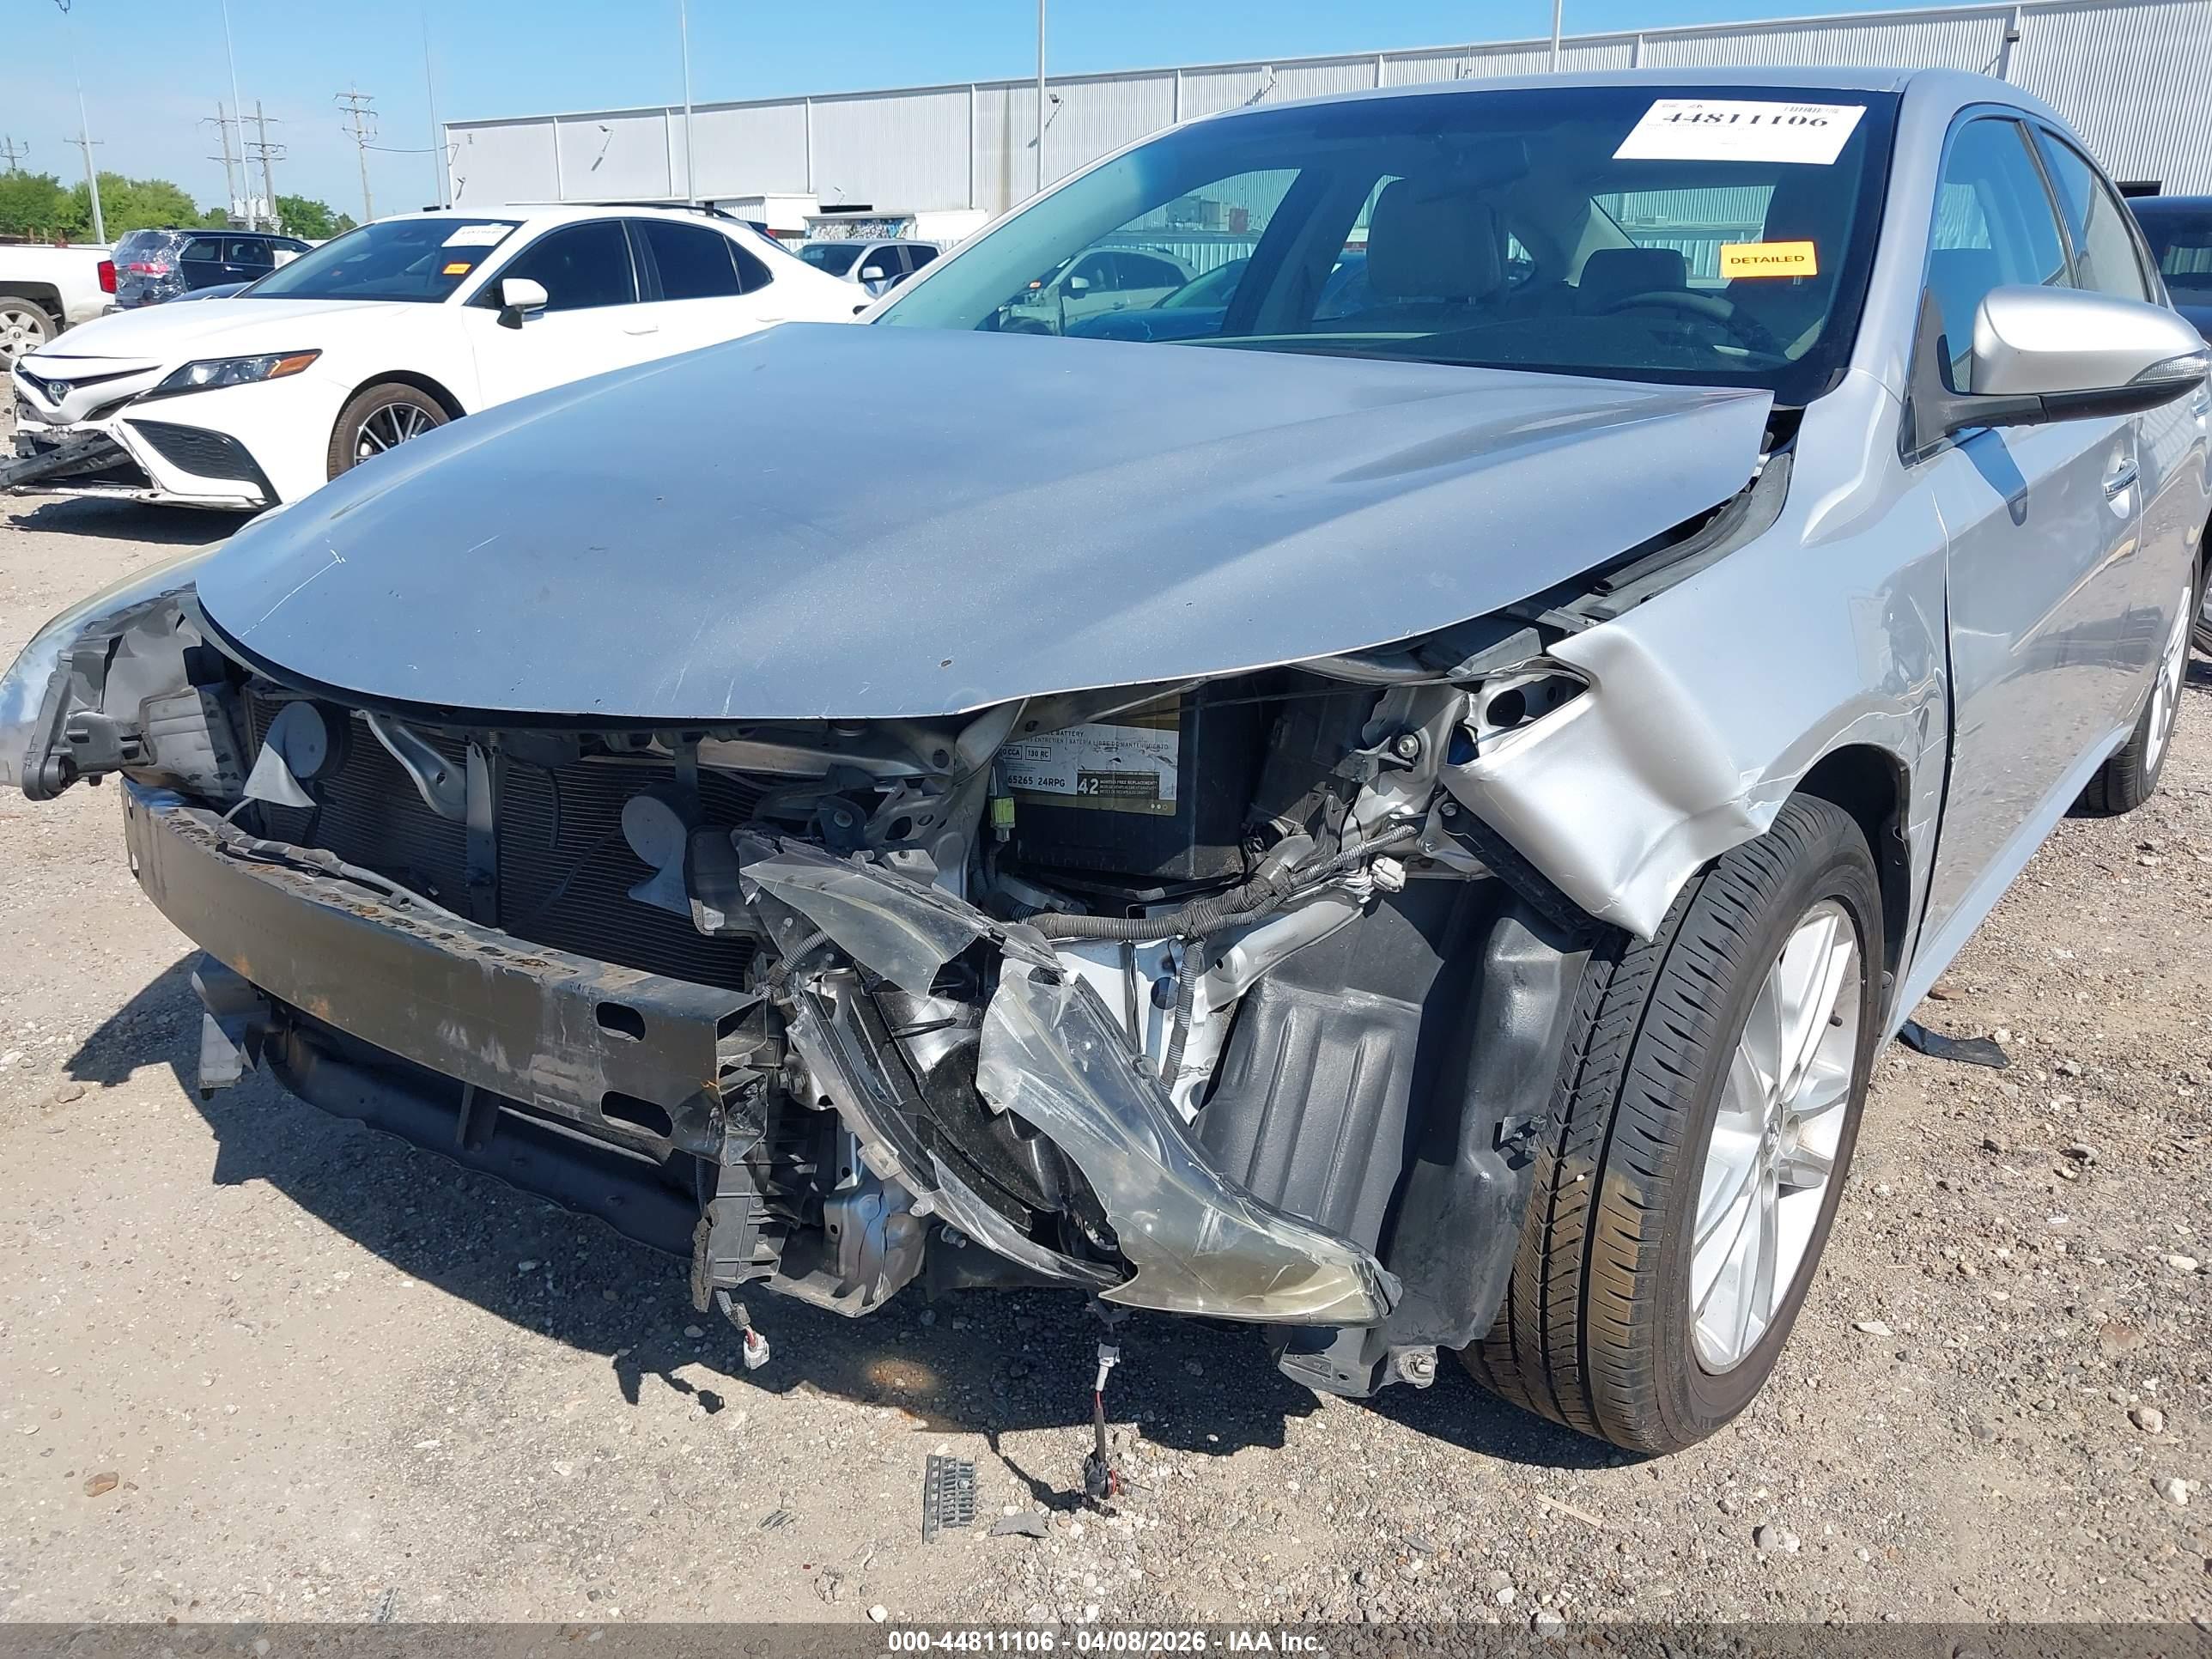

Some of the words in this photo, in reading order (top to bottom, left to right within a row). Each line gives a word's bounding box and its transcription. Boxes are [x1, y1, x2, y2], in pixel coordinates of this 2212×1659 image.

[1662, 112, 1828, 127] 44811106
[1730, 255, 1805, 264] DETAILED
[1007, 748, 1020, 757] CCA
[1008, 775, 1034, 786] 65265
[1037, 776, 1066, 788] 24RPG
[1078, 778, 1099, 794] 42
